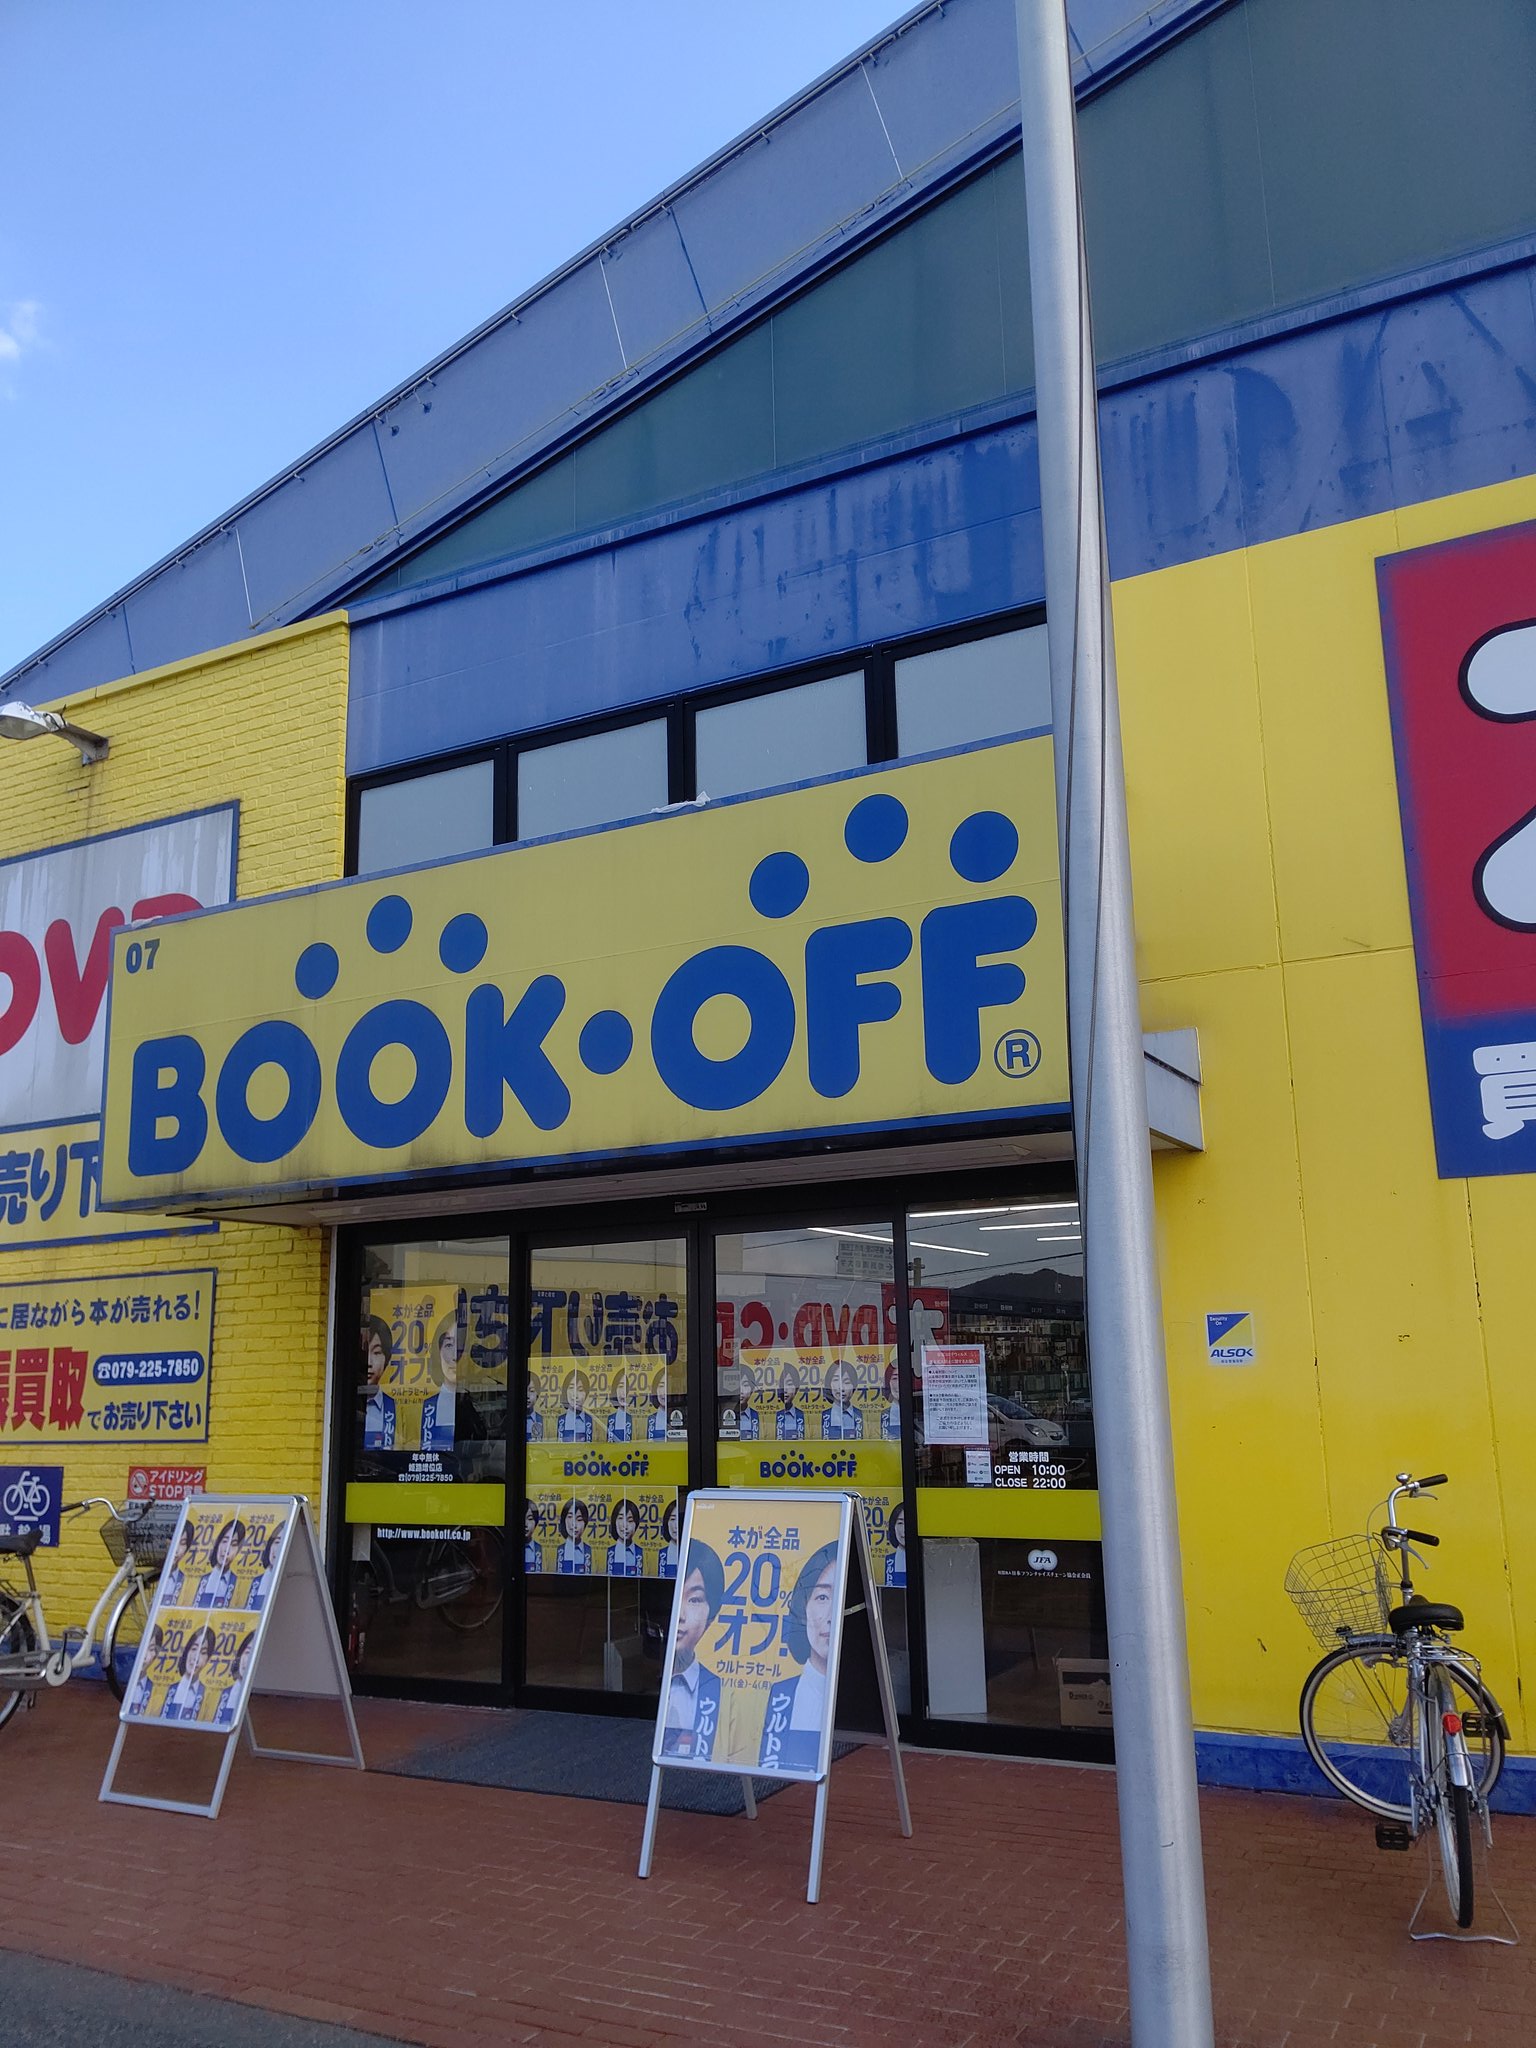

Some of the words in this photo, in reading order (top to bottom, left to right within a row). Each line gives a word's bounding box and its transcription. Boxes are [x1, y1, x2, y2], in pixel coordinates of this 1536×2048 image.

[125, 938, 161, 974] 07
[393, 1304, 434, 1319] 本が全品
[856, 1354, 884, 1363] 本が全品
[1210, 1348, 1253, 1358] ALSOK
[753, 1357, 781, 1365] 本が全品
[798, 1355, 826, 1365] 本が全品
[112, 1358, 199, 1379] 079-225-7850
[391, 1387, 429, 1396] ウルトラセール
[88, 1400, 201, 1431] でお売り下さい
[384, 1411, 394, 1450] ウルト
[412, 1453, 439, 1462] 年中無休
[1008, 1451, 1049, 1463] 営業時間
[994, 1464, 1021, 1475] OPEN
[1032, 1464, 1066, 1476] 10:00
[149, 1469, 204, 1484] アイドリング
[995, 1477, 1028, 1487] CLOSE
[1032, 1477, 1067, 1489] 22:00
[638, 1495, 664, 1503] 本が全品
[377, 1528, 471, 1541] http://www.bookoff.co.jp
[727, 1525, 800, 1550] 本が全品
[1033, 1556, 1052, 1564] JFA
[721, 1552, 793, 1608] 20%
[714, 1608, 789, 1657] オフ!
[715, 1660, 782, 1678] ウルトラセール
